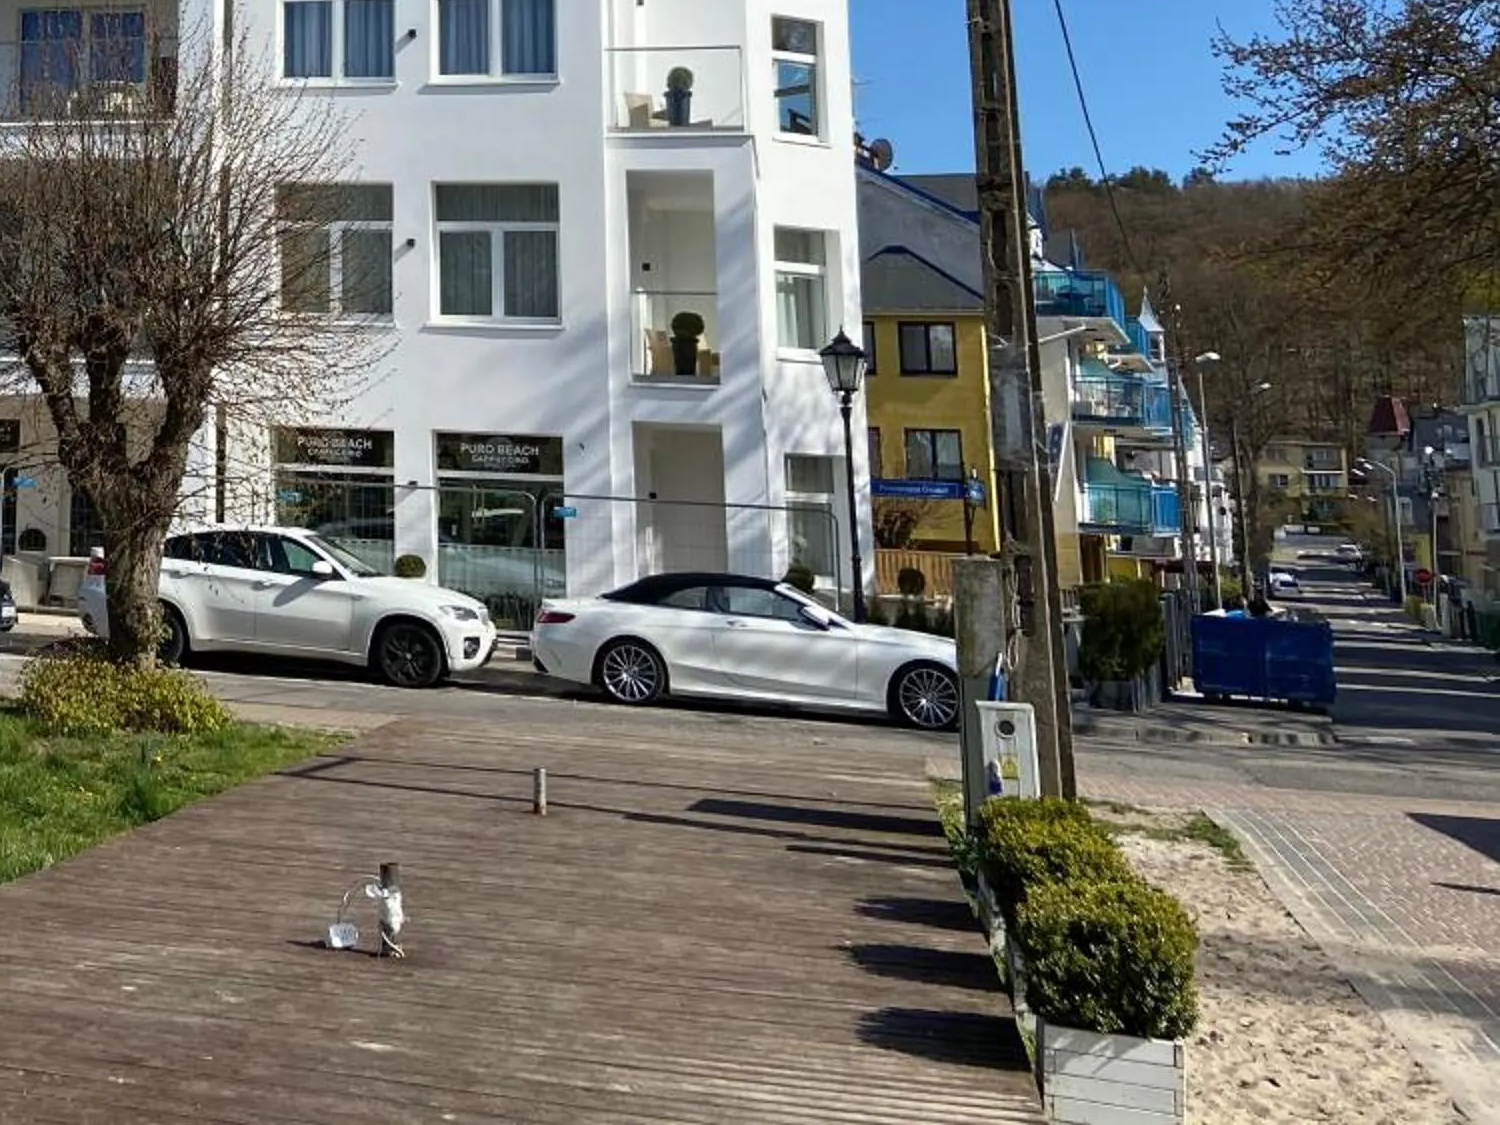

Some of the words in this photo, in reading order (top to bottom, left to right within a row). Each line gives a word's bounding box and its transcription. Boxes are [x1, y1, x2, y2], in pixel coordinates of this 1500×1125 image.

[297, 435, 329, 448] PURO
[331, 437, 373, 450] BEACH
[460, 442, 495, 454] PURO
[497, 444, 539, 456] BEACH
